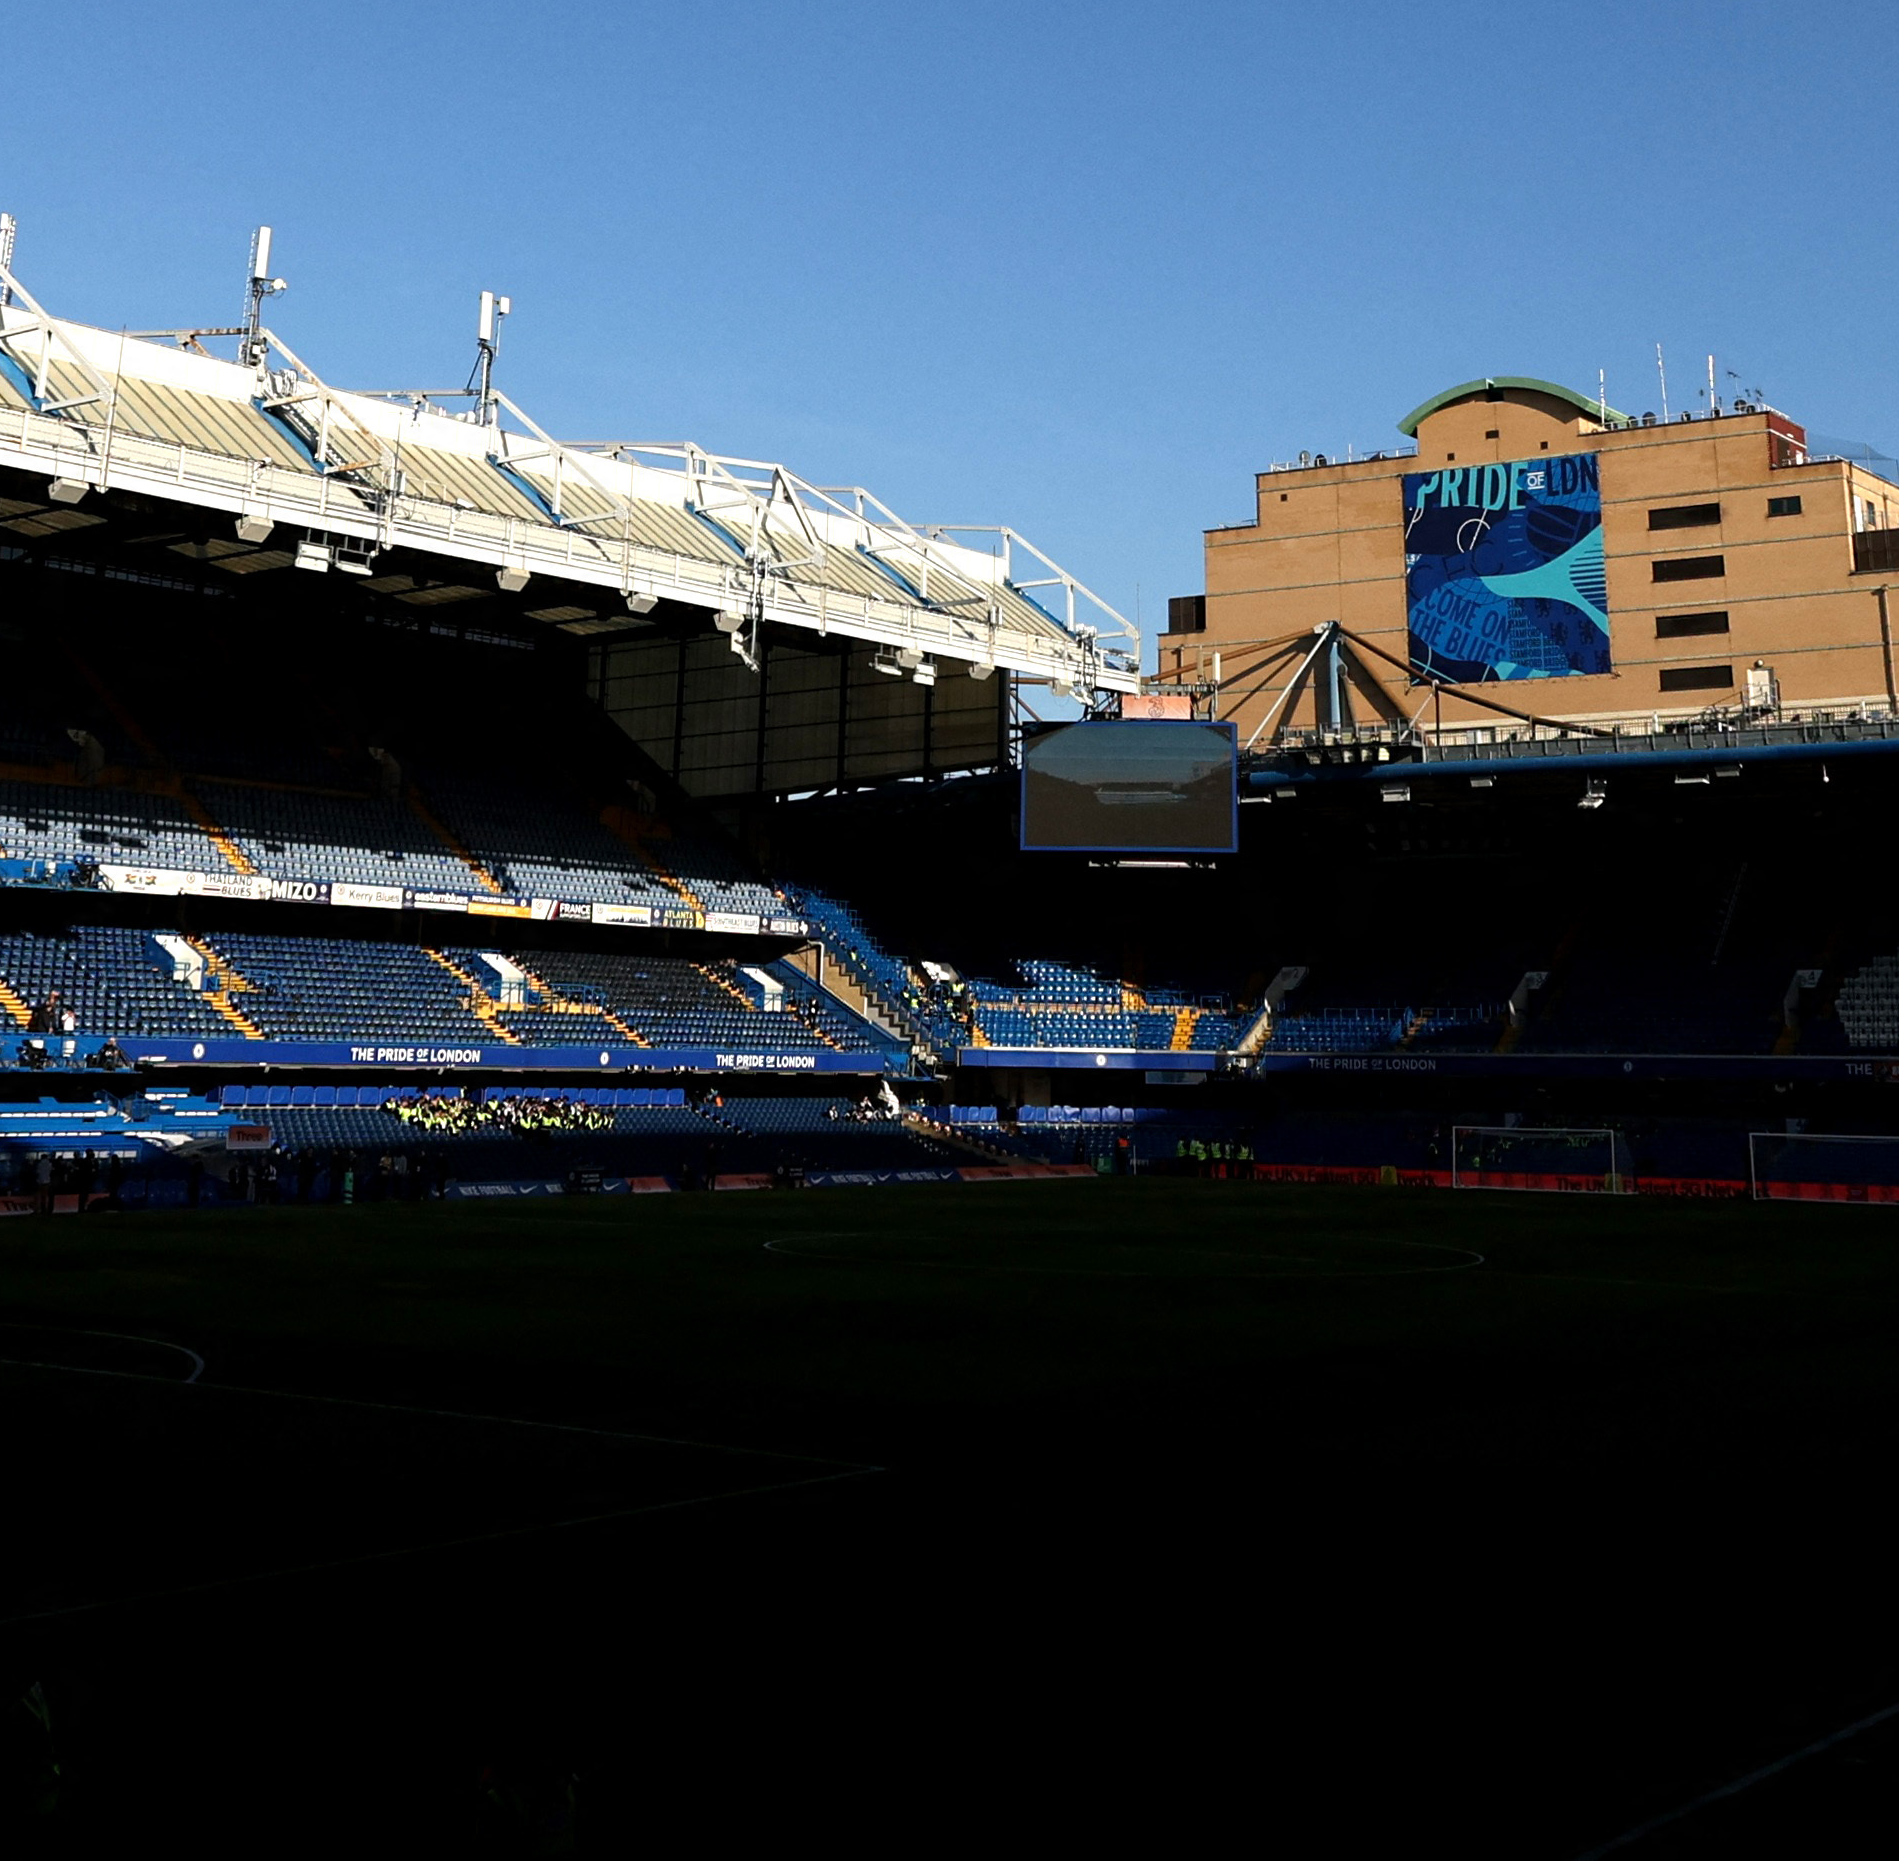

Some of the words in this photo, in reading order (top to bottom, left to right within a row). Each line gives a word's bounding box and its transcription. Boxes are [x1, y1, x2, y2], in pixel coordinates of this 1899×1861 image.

[1417, 462, 1528, 511] PRIDE
[1527, 472, 1545, 493] OF
[1546, 455, 1599, 496] LDN
[1424, 585, 1481, 630] COME
[1411, 608, 1447, 647] THE
[204, 874, 253, 887] THAILAND
[221, 886, 252, 897] BLUES
[272, 880, 317, 901] MIZO
[349, 890, 373, 903] Kerry
[376, 892, 400, 903] Blues
[559, 904, 591, 915] FRANCE
[664, 910, 694, 919] ATLANTA
[350, 1047, 375, 1061] THE
[377, 1047, 415, 1061] PRIDE
[416, 1049, 429, 1062] OF
[430, 1049, 481, 1063] LONDON
[716, 1054, 735, 1067] THE
[736, 1055, 765, 1067] PRIDE
[765, 1056, 776, 1068] OF
[776, 1056, 816, 1069] LONDON
[1309, 1058, 1331, 1070] THE
[1333, 1058, 1369, 1070] PRIDE
[1370, 1059, 1383, 1070] OF
[1385, 1059, 1437, 1071] LONDON
[1845, 1063, 1873, 1076] THE
